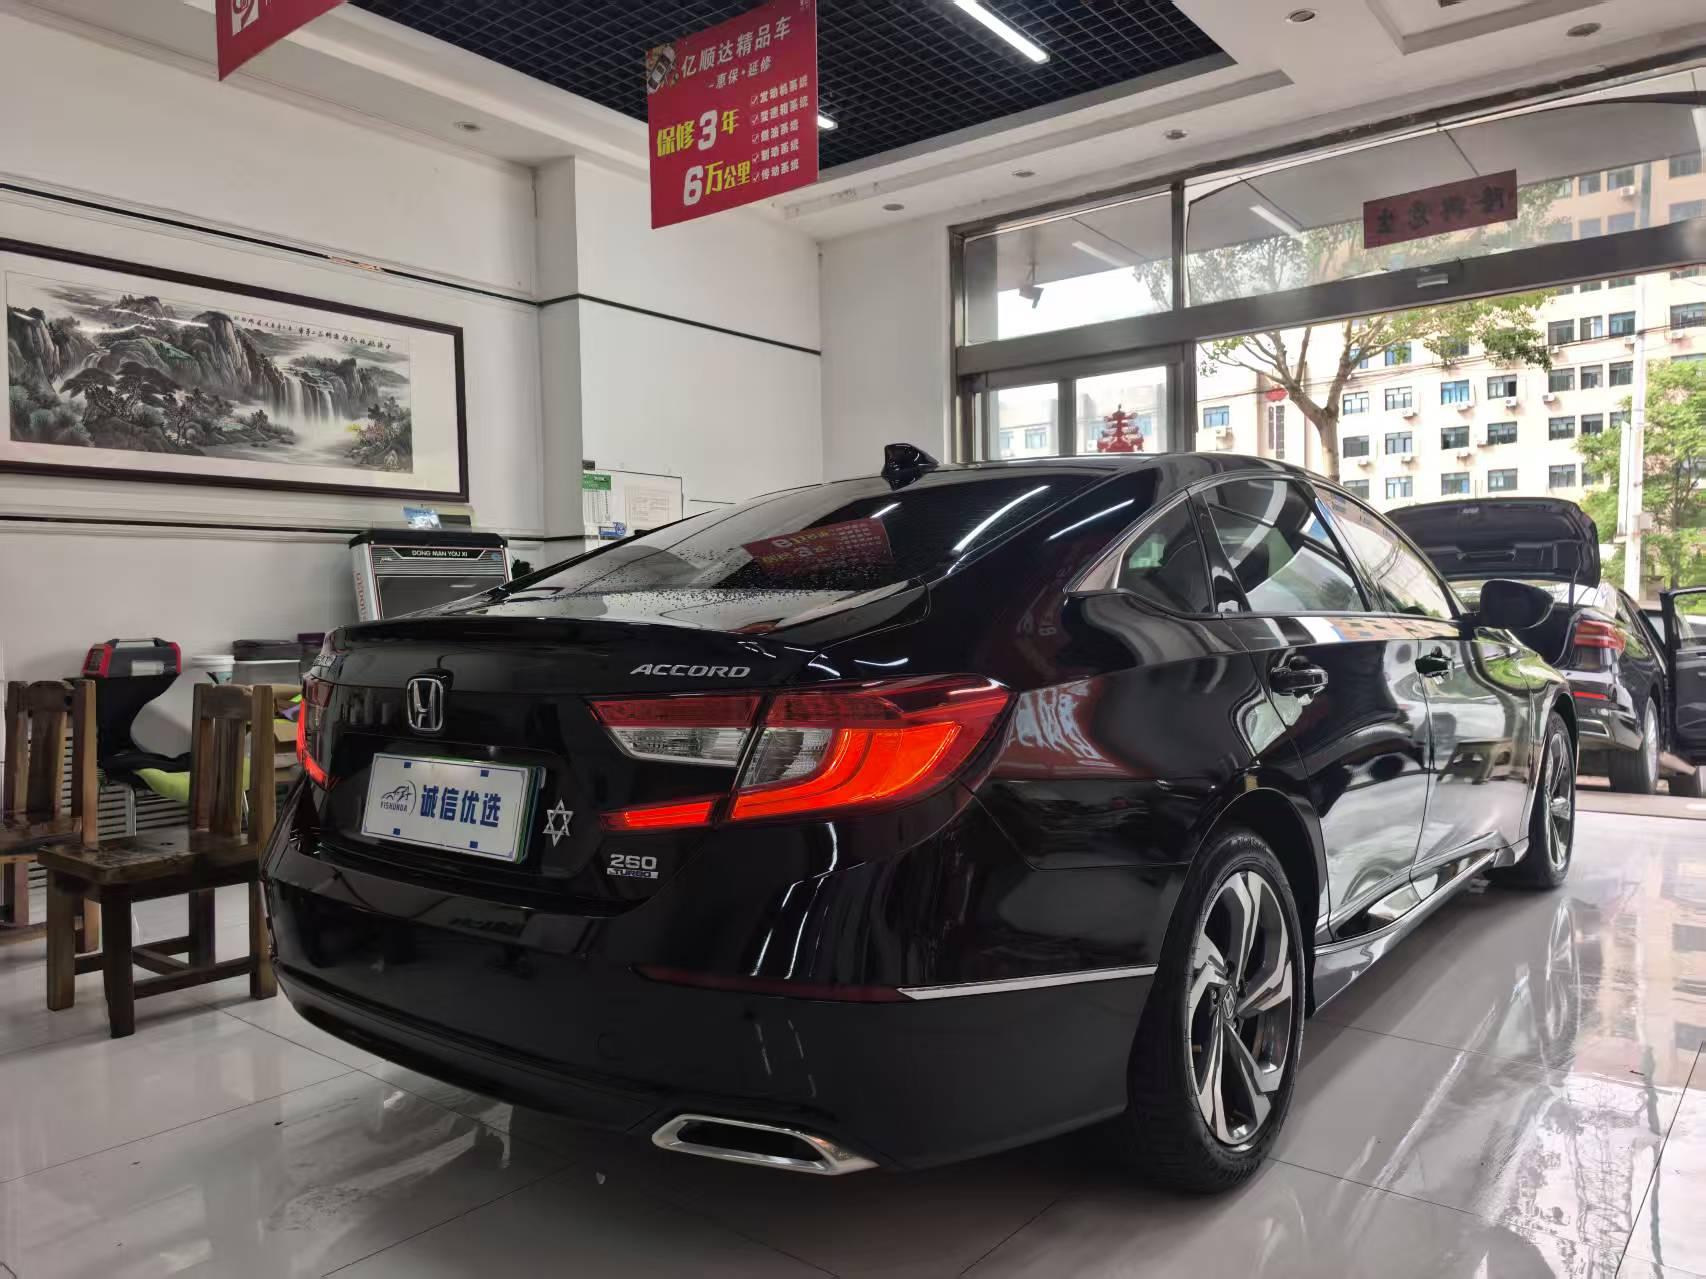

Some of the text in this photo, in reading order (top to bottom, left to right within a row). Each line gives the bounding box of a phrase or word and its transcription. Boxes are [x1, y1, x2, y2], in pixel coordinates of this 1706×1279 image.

[681, 16, 792, 79] 亿顺达精品车
[682, 159, 750, 207] 6万公里
[629, 663, 752, 678] ACCORD
[420, 784, 502, 828] 诚信优选
